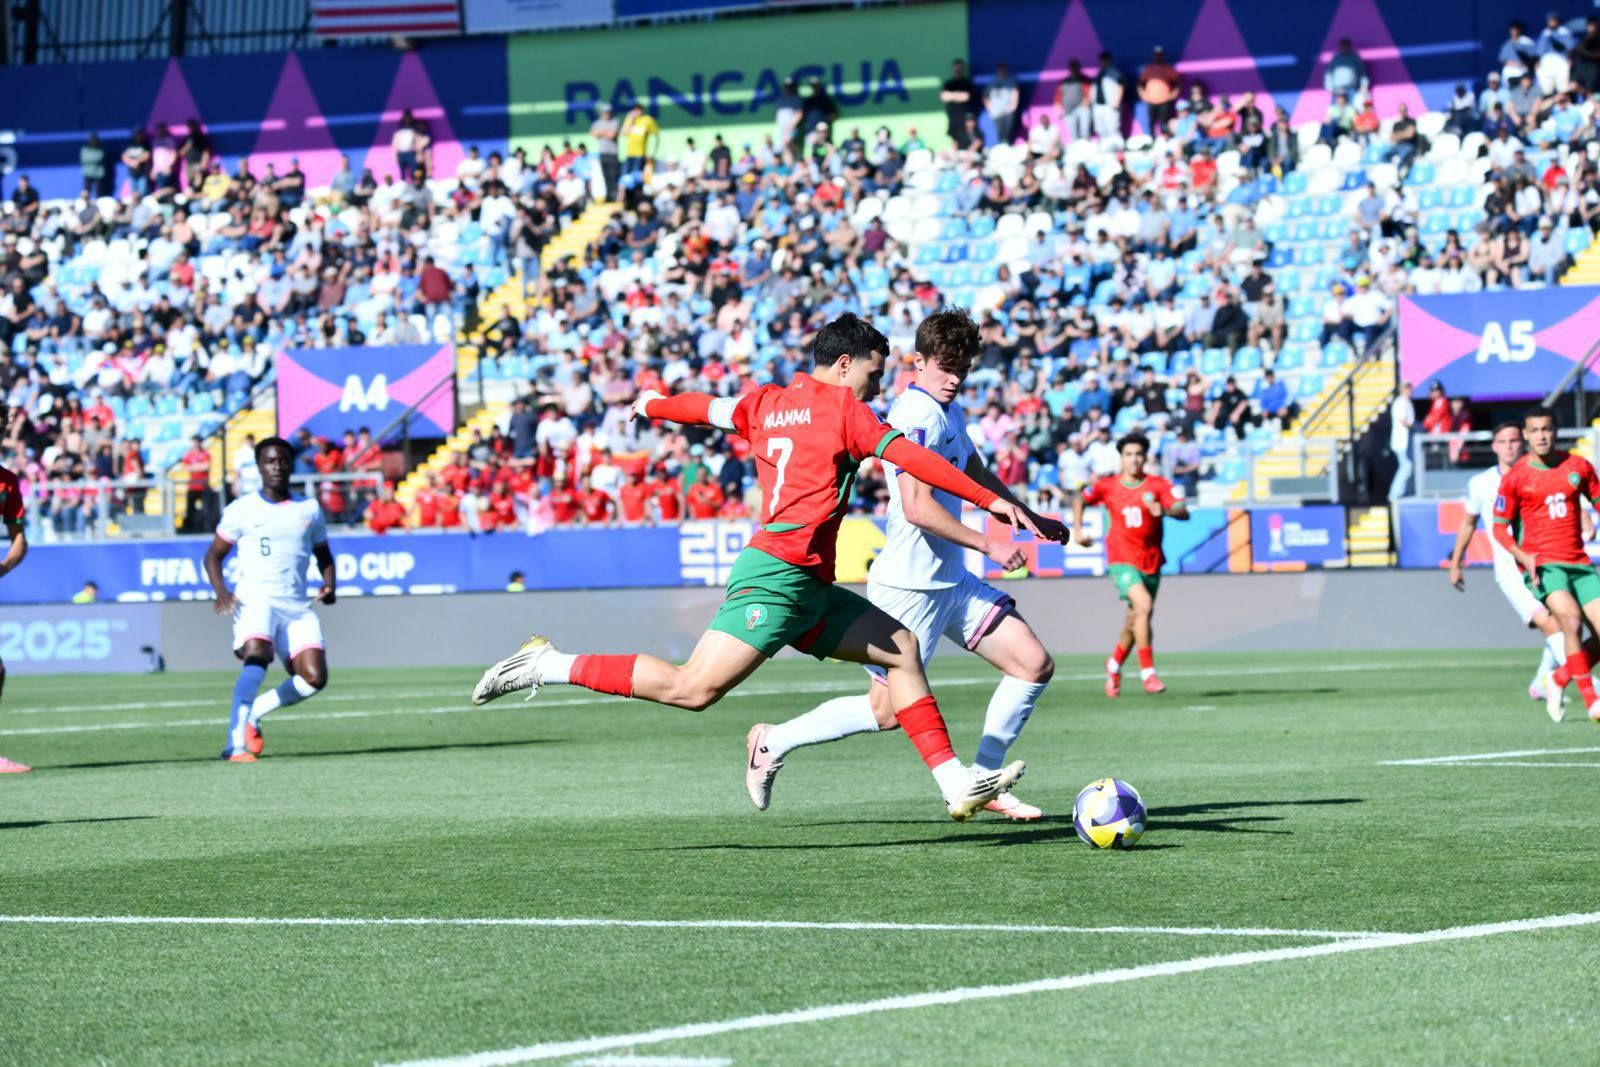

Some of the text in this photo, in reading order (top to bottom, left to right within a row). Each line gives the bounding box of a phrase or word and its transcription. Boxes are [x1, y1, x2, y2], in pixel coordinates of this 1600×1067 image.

[1475, 320, 1537, 364] A5
[338, 373, 389, 413] A4
[763, 407, 812, 431] MAMMA
[766, 437, 794, 516] 7
[1121, 505, 1143, 528] 10
[1544, 492, 1567, 520] 16
[260, 537, 271, 556] 6
[141, 558, 198, 586] FIFA
[360, 551, 415, 581] CUP
